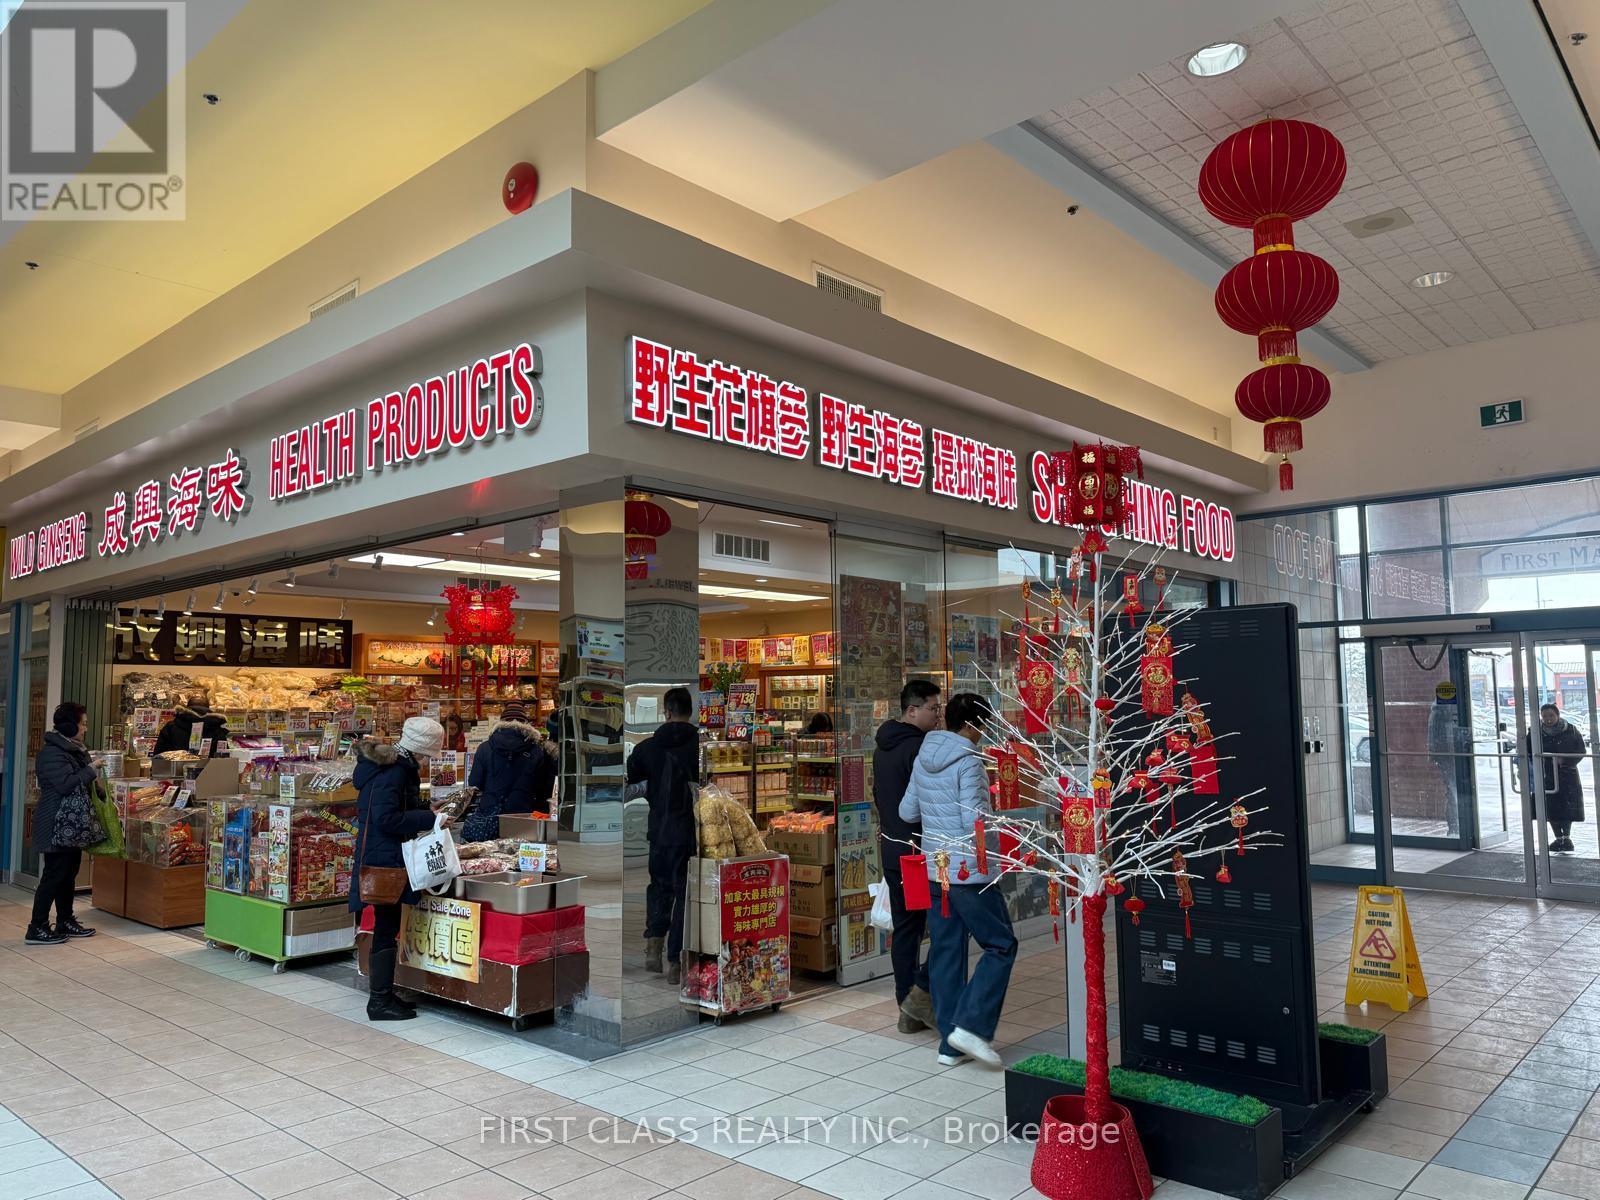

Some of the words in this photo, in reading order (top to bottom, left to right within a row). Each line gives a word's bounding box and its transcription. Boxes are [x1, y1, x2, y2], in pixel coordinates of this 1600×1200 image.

[269, 408, 357, 501] HEALTH
[366, 342, 536, 471] PRODUCTS
[630, 334, 811, 460] 野生花旗參
[820, 393, 926, 489] 野生海參
[930, 428, 1018, 510] 環球海味
[98, 448, 246, 556] 成興海味
[1181, 495, 1235, 562] FOOD
[10, 531, 36, 580] WILD
[37, 511, 87, 572] GINSENG
[1500, 551, 1560, 571] FIRST
[432, 900, 449, 914] Sale
[450, 902, 471, 917] Zone
[1363, 960, 1391, 969] ATTENTION
